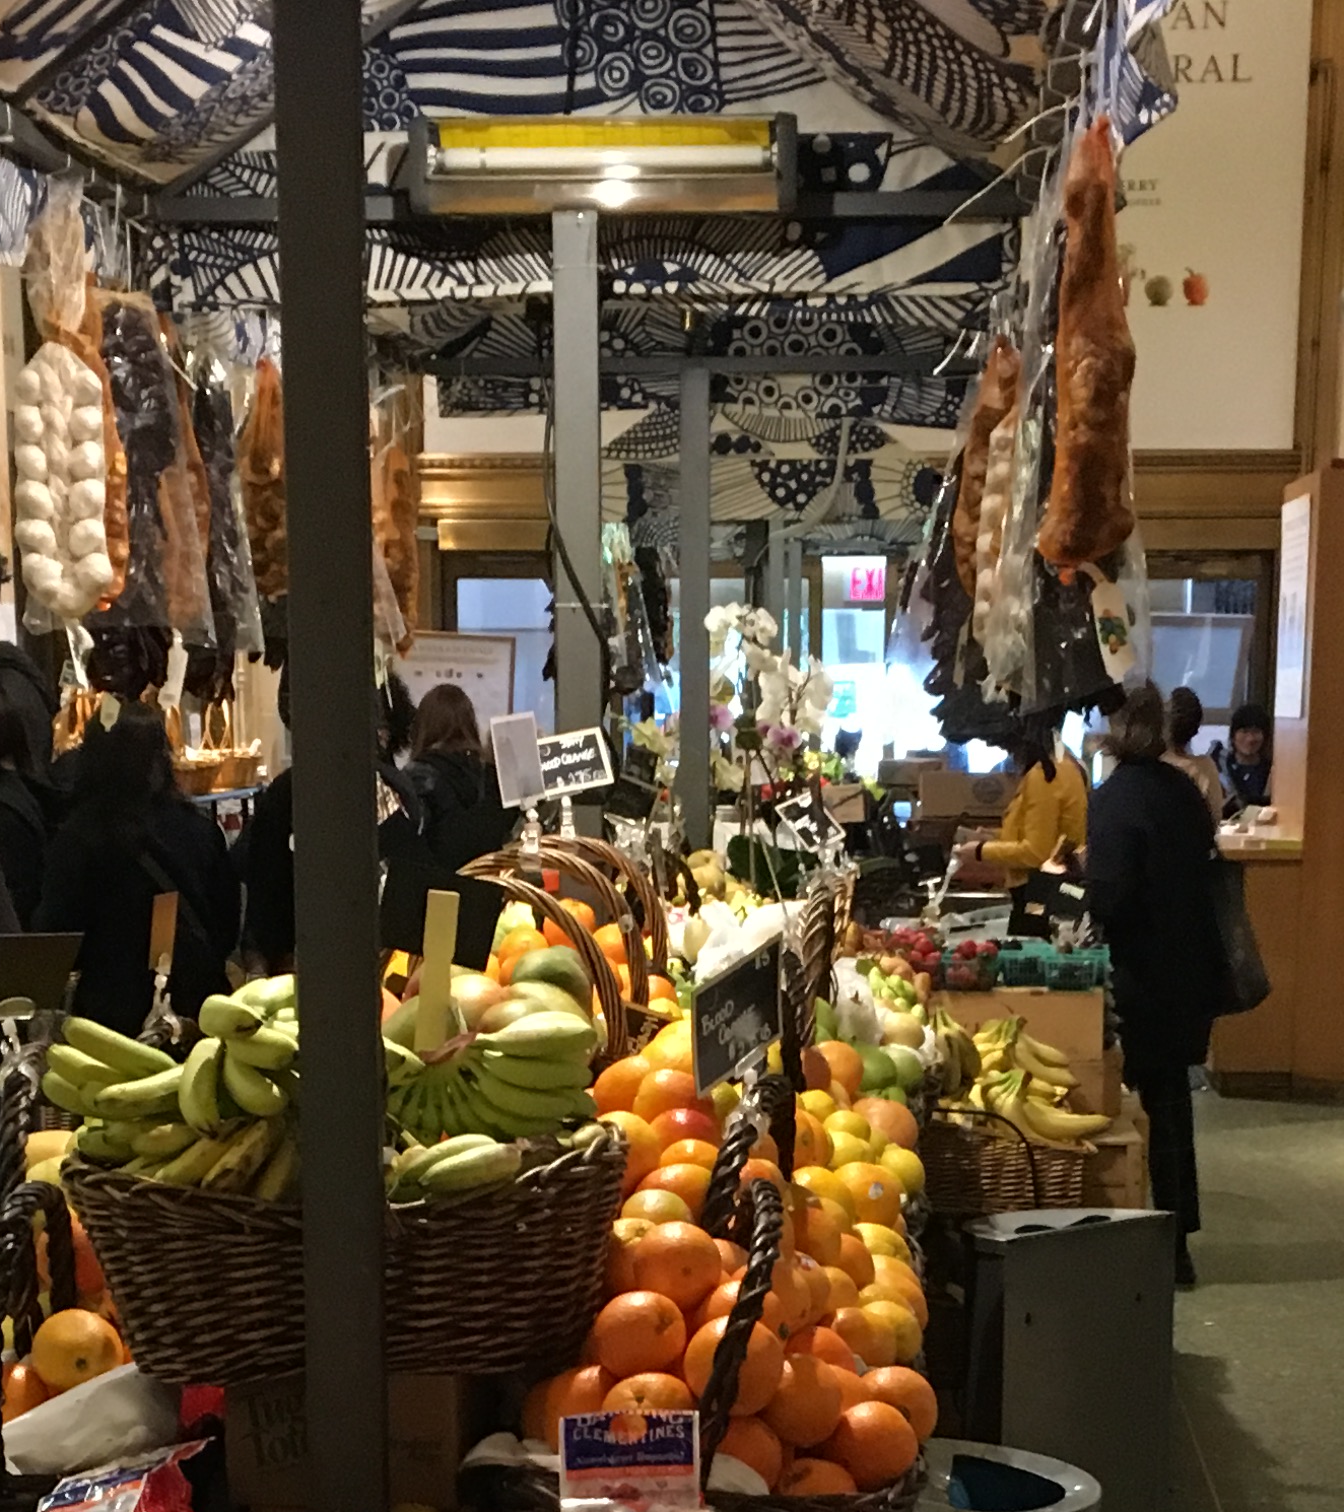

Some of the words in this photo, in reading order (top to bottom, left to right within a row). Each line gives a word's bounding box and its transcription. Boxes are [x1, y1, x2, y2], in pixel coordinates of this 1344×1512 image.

[1171, 1, 1228, 30] AN
[1173, 53, 1253, 83] RAL
[851, 567, 885, 600] EXI
